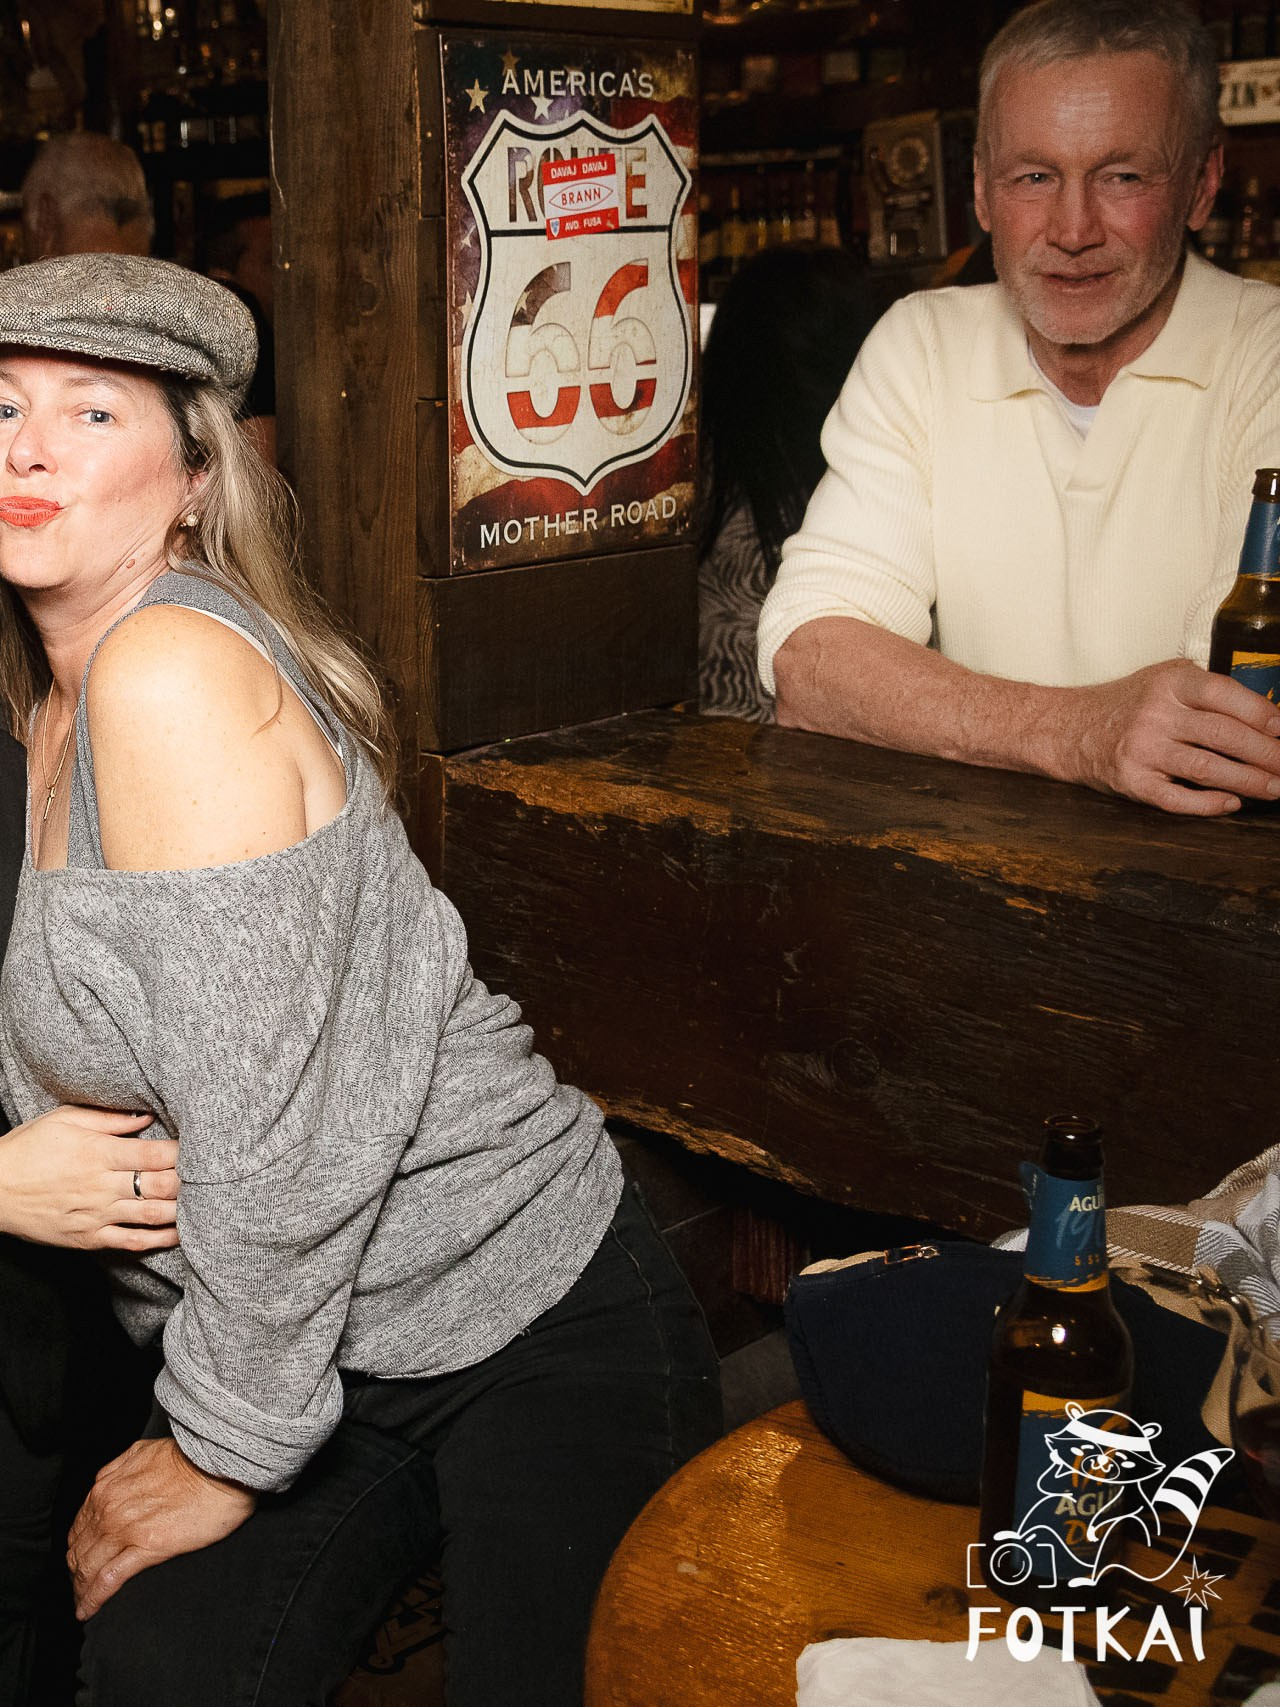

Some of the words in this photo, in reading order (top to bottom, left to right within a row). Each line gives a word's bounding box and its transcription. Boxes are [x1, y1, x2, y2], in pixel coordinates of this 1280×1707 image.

[501, 68, 654, 98] AMERICA'S
[550, 165, 577, 179] DAVAJ
[582, 161, 608, 174] DAVAJ
[561, 188, 602, 206] BRANN
[505, 257, 657, 445] 66
[480, 508, 598, 548] MOTHER
[610, 496, 677, 527] ROAD
